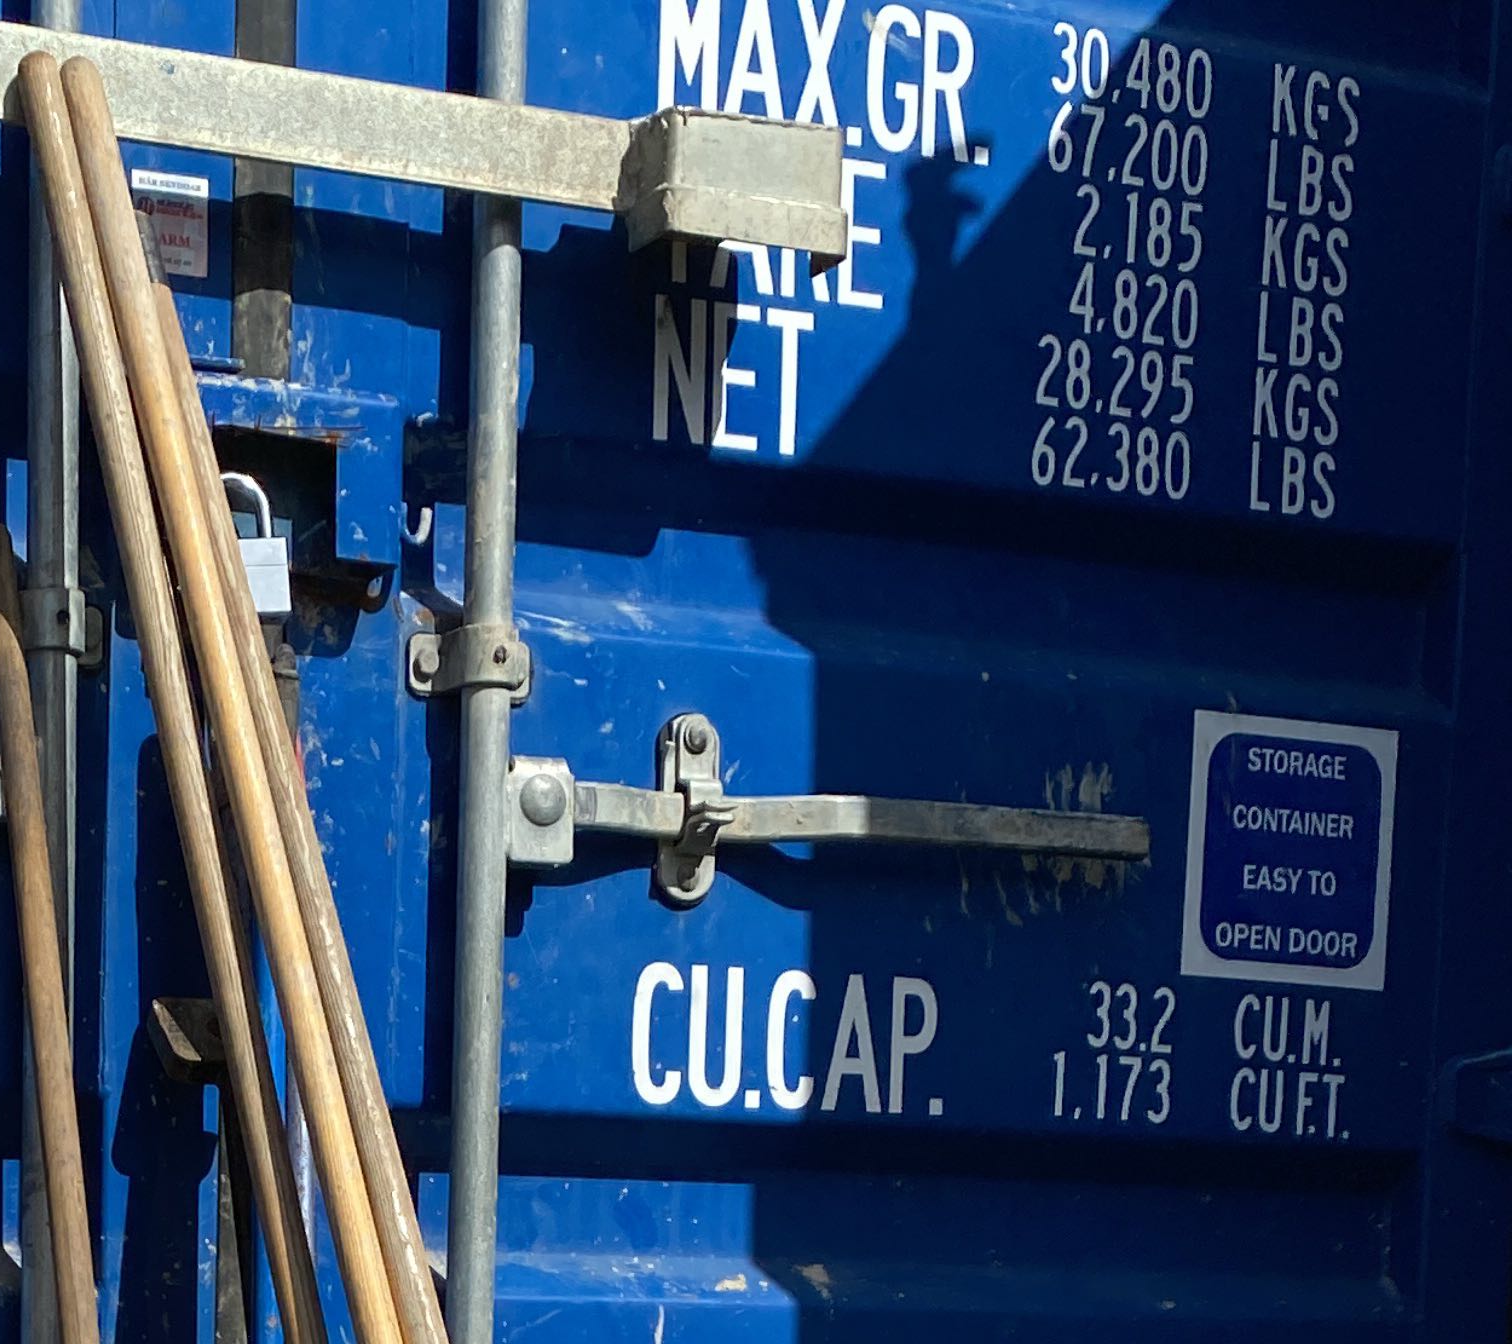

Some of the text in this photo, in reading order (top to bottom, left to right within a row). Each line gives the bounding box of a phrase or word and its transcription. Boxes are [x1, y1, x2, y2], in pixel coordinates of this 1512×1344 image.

[1051, 22, 1213, 119] 30,480
[1272, 63, 1361, 147] KGS
[1048, 100, 1356, 223] 67,200 LBS
[1073, 184, 1350, 296] 2,185 KGS
[1069, 262, 1345, 373] 4,820 LBS
[652, 294, 1340, 456] NET 28,295 KGS
[1031, 415, 1337, 519] 62,380 LBS
[1247, 747, 1347, 781] STORAGE
[1233, 804, 1355, 840] CONTAINER
[1243, 864, 1337, 896] EASY TO
[1215, 921, 1359, 958] OPEN DOOR
[631, 962, 1342, 1117] CU.CAP. 33.2 CU.M.
[1053, 1050, 1172, 1124] 1,173
